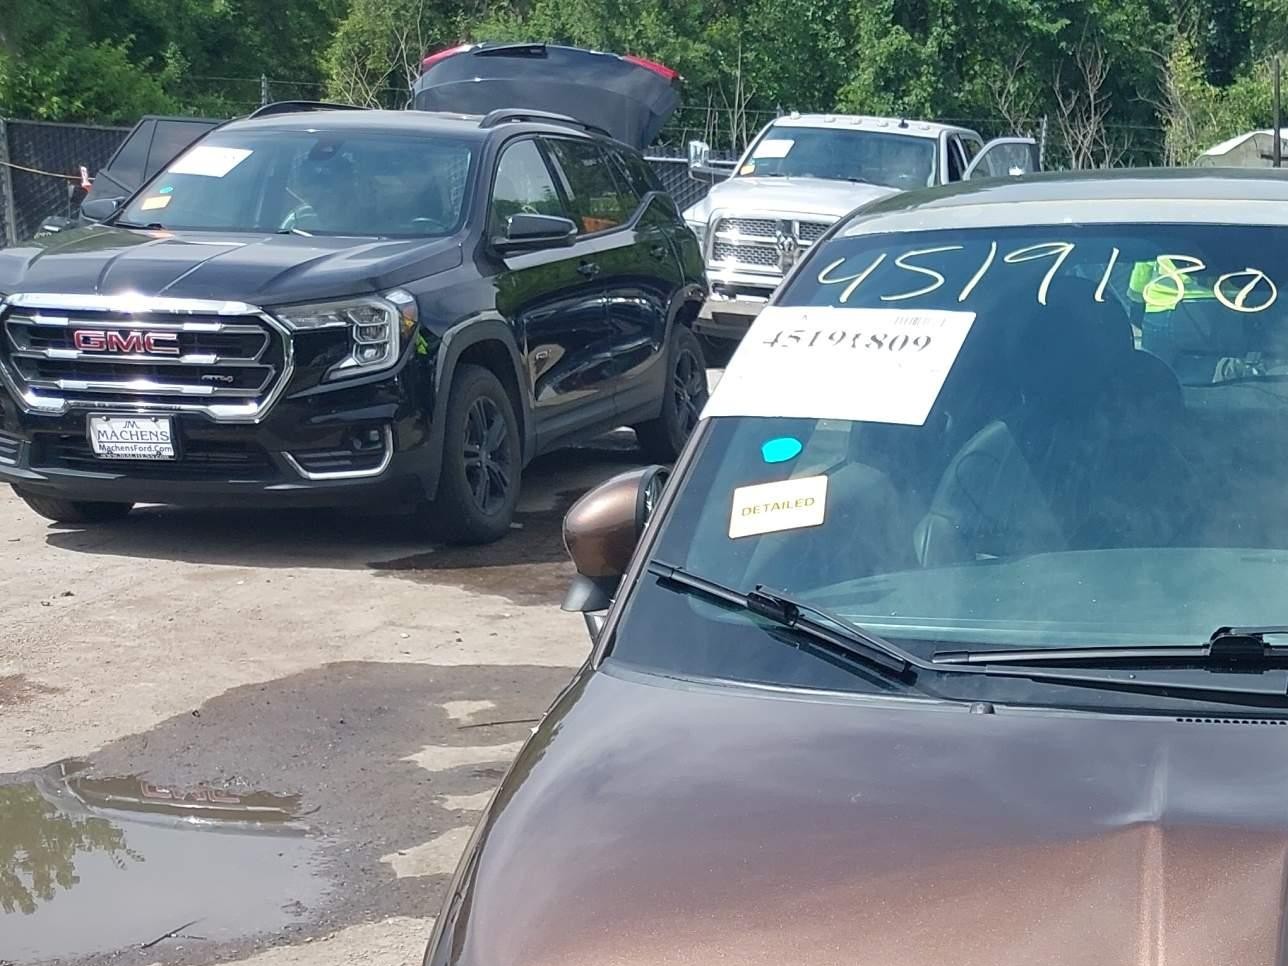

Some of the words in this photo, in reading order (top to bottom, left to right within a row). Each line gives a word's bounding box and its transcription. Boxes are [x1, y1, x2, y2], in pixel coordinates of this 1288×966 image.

[74, 330, 180, 354] GMC
[97, 430, 169, 441] MACHENS
[98, 444, 172, 453] MachensFord.Com
[741, 497, 815, 516] DETAILED
